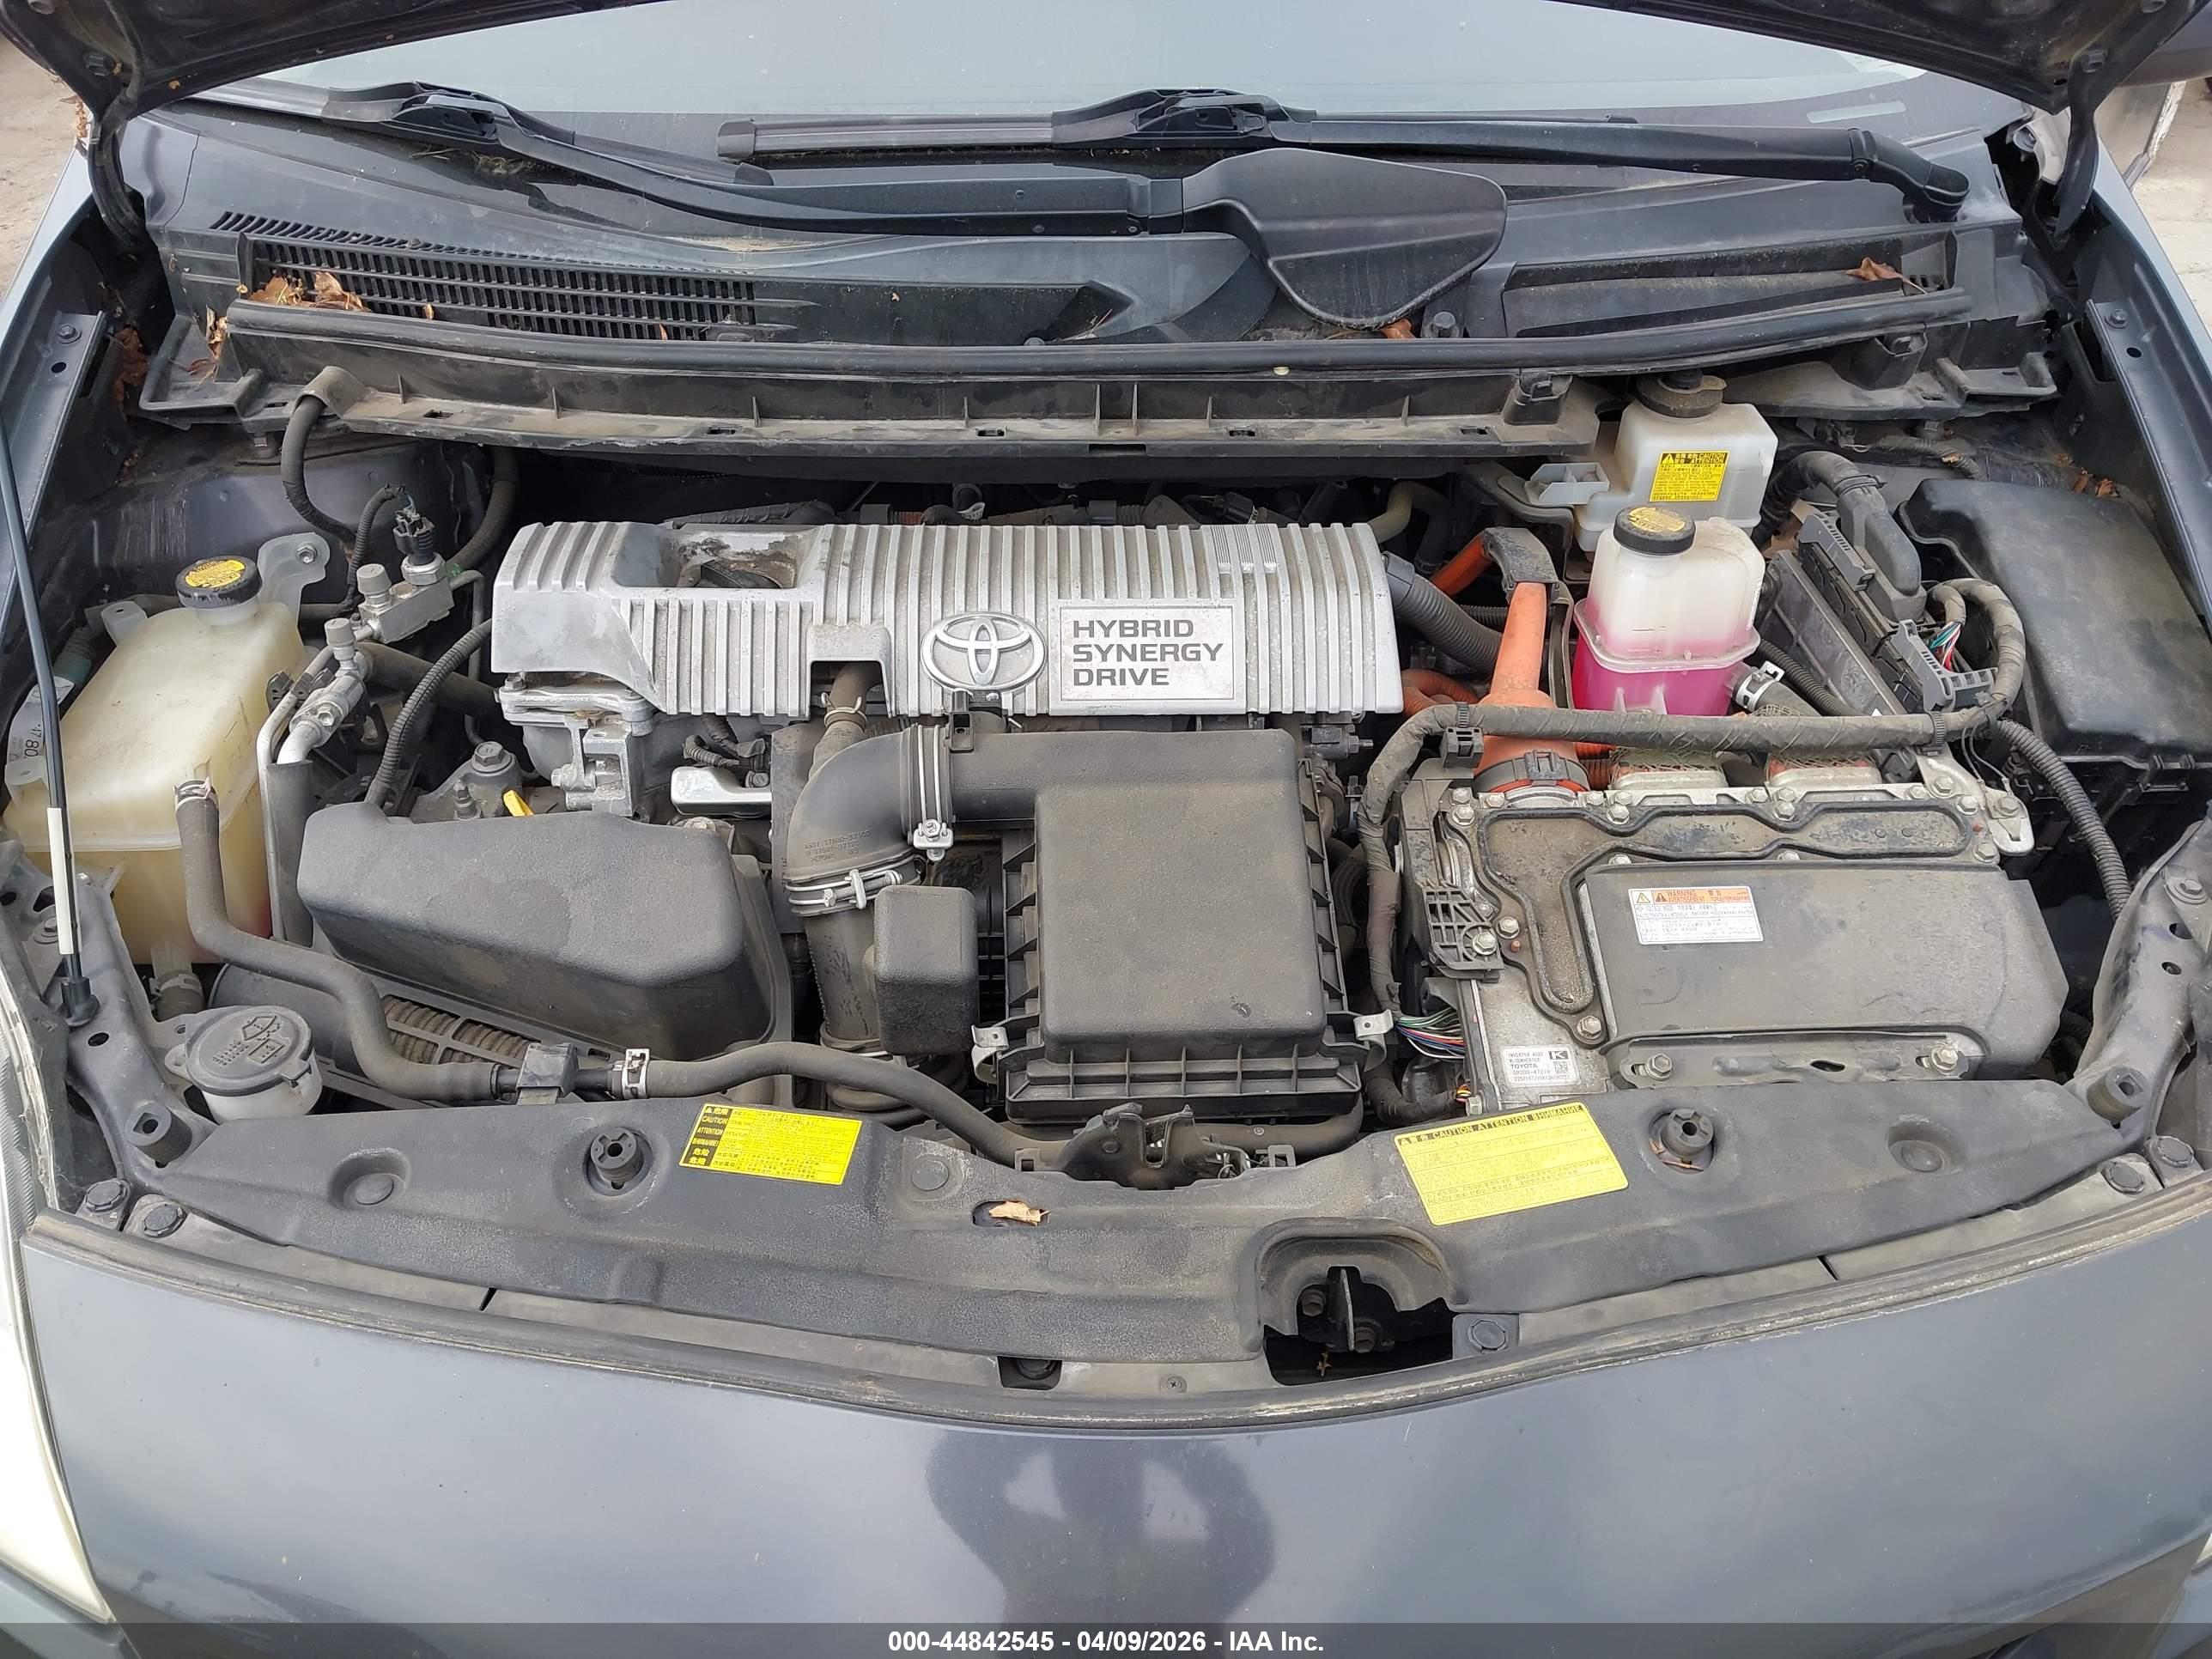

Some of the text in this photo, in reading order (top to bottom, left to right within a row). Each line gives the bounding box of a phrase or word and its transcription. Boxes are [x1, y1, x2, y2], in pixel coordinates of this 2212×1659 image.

[1073, 619, 1194, 638] HYBRID
[1073, 642, 1224, 663] SYNERGY
[1073, 668, 1170, 686] DRIVE
[701, 1115, 728, 1125] CAUTION
[1433, 1125, 1474, 1139] CAUTION
[1478, 1115, 1529, 1131] ATTENTION
[696, 1127, 724, 1135] ATTENTION
